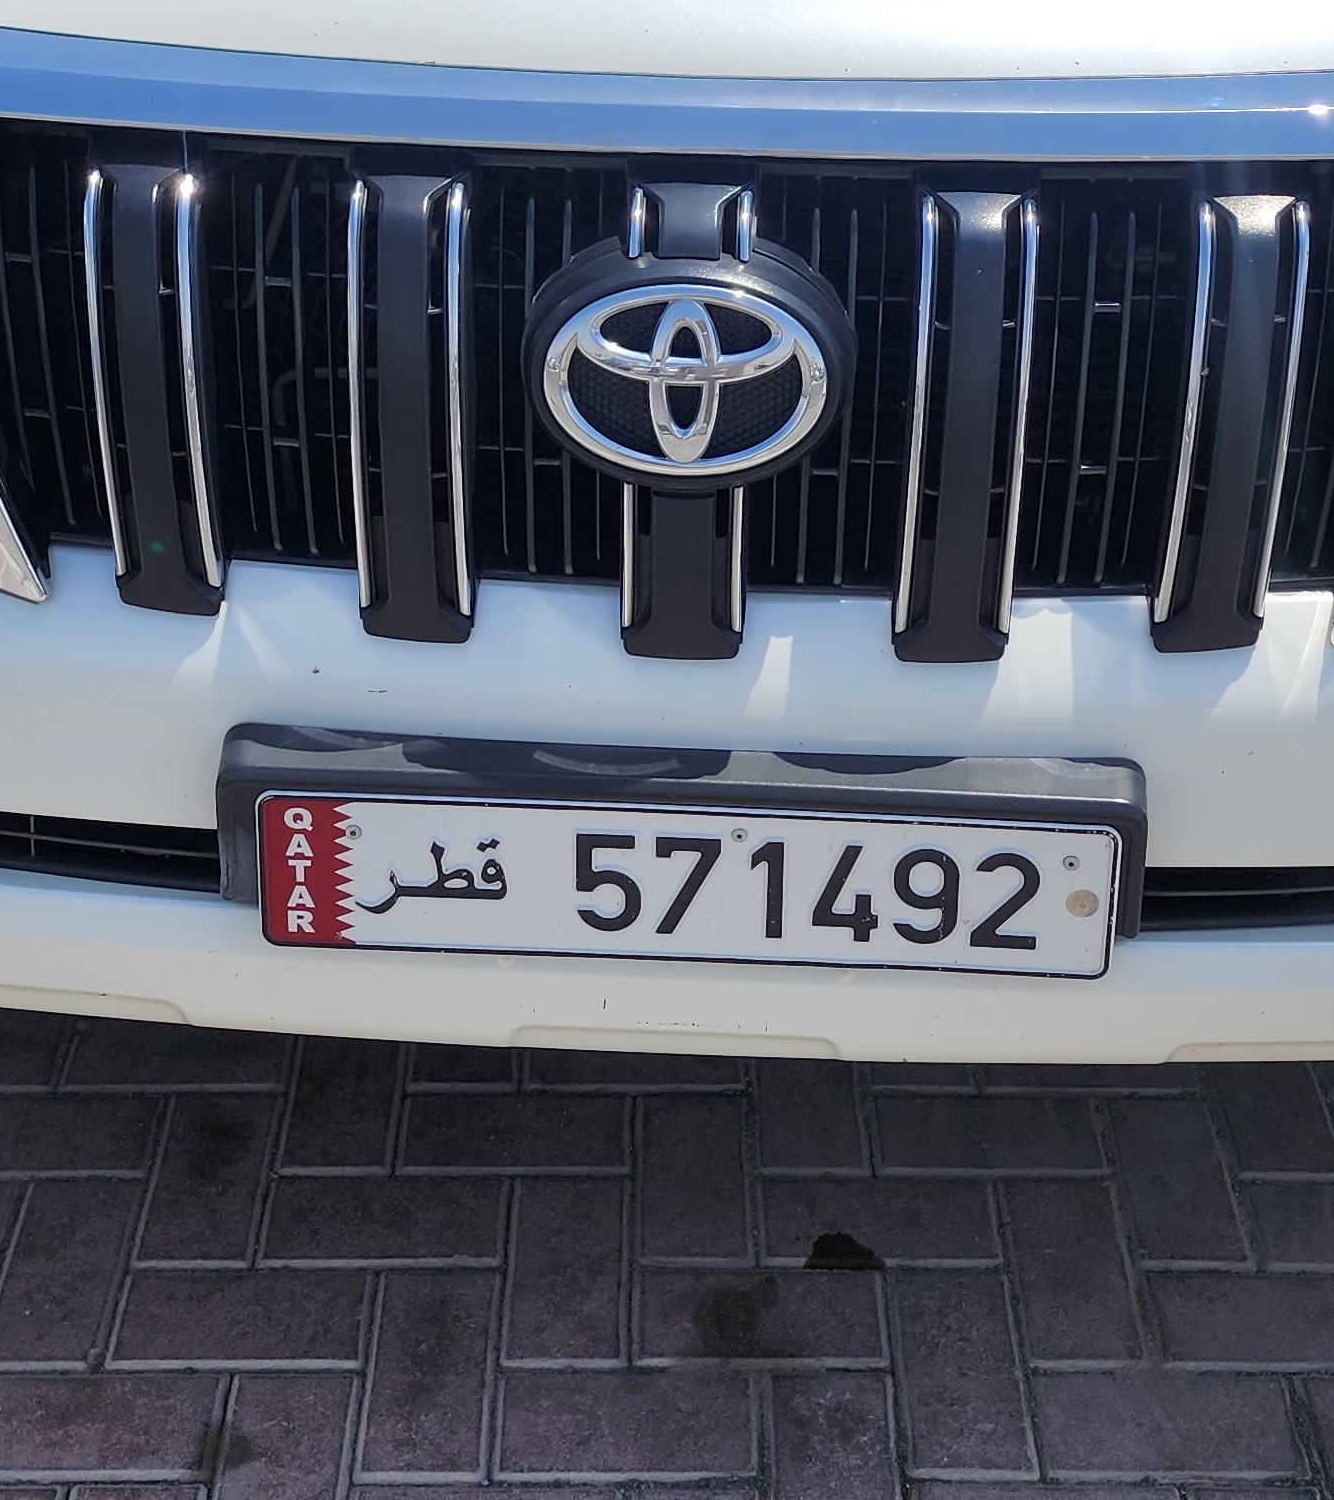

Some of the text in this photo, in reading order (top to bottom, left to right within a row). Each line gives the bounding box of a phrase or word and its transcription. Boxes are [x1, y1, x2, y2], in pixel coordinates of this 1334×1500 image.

[282, 806, 316, 934] QATAR
[354, 837, 509, 915] قطر
[574, 832, 1042, 952] 571492
